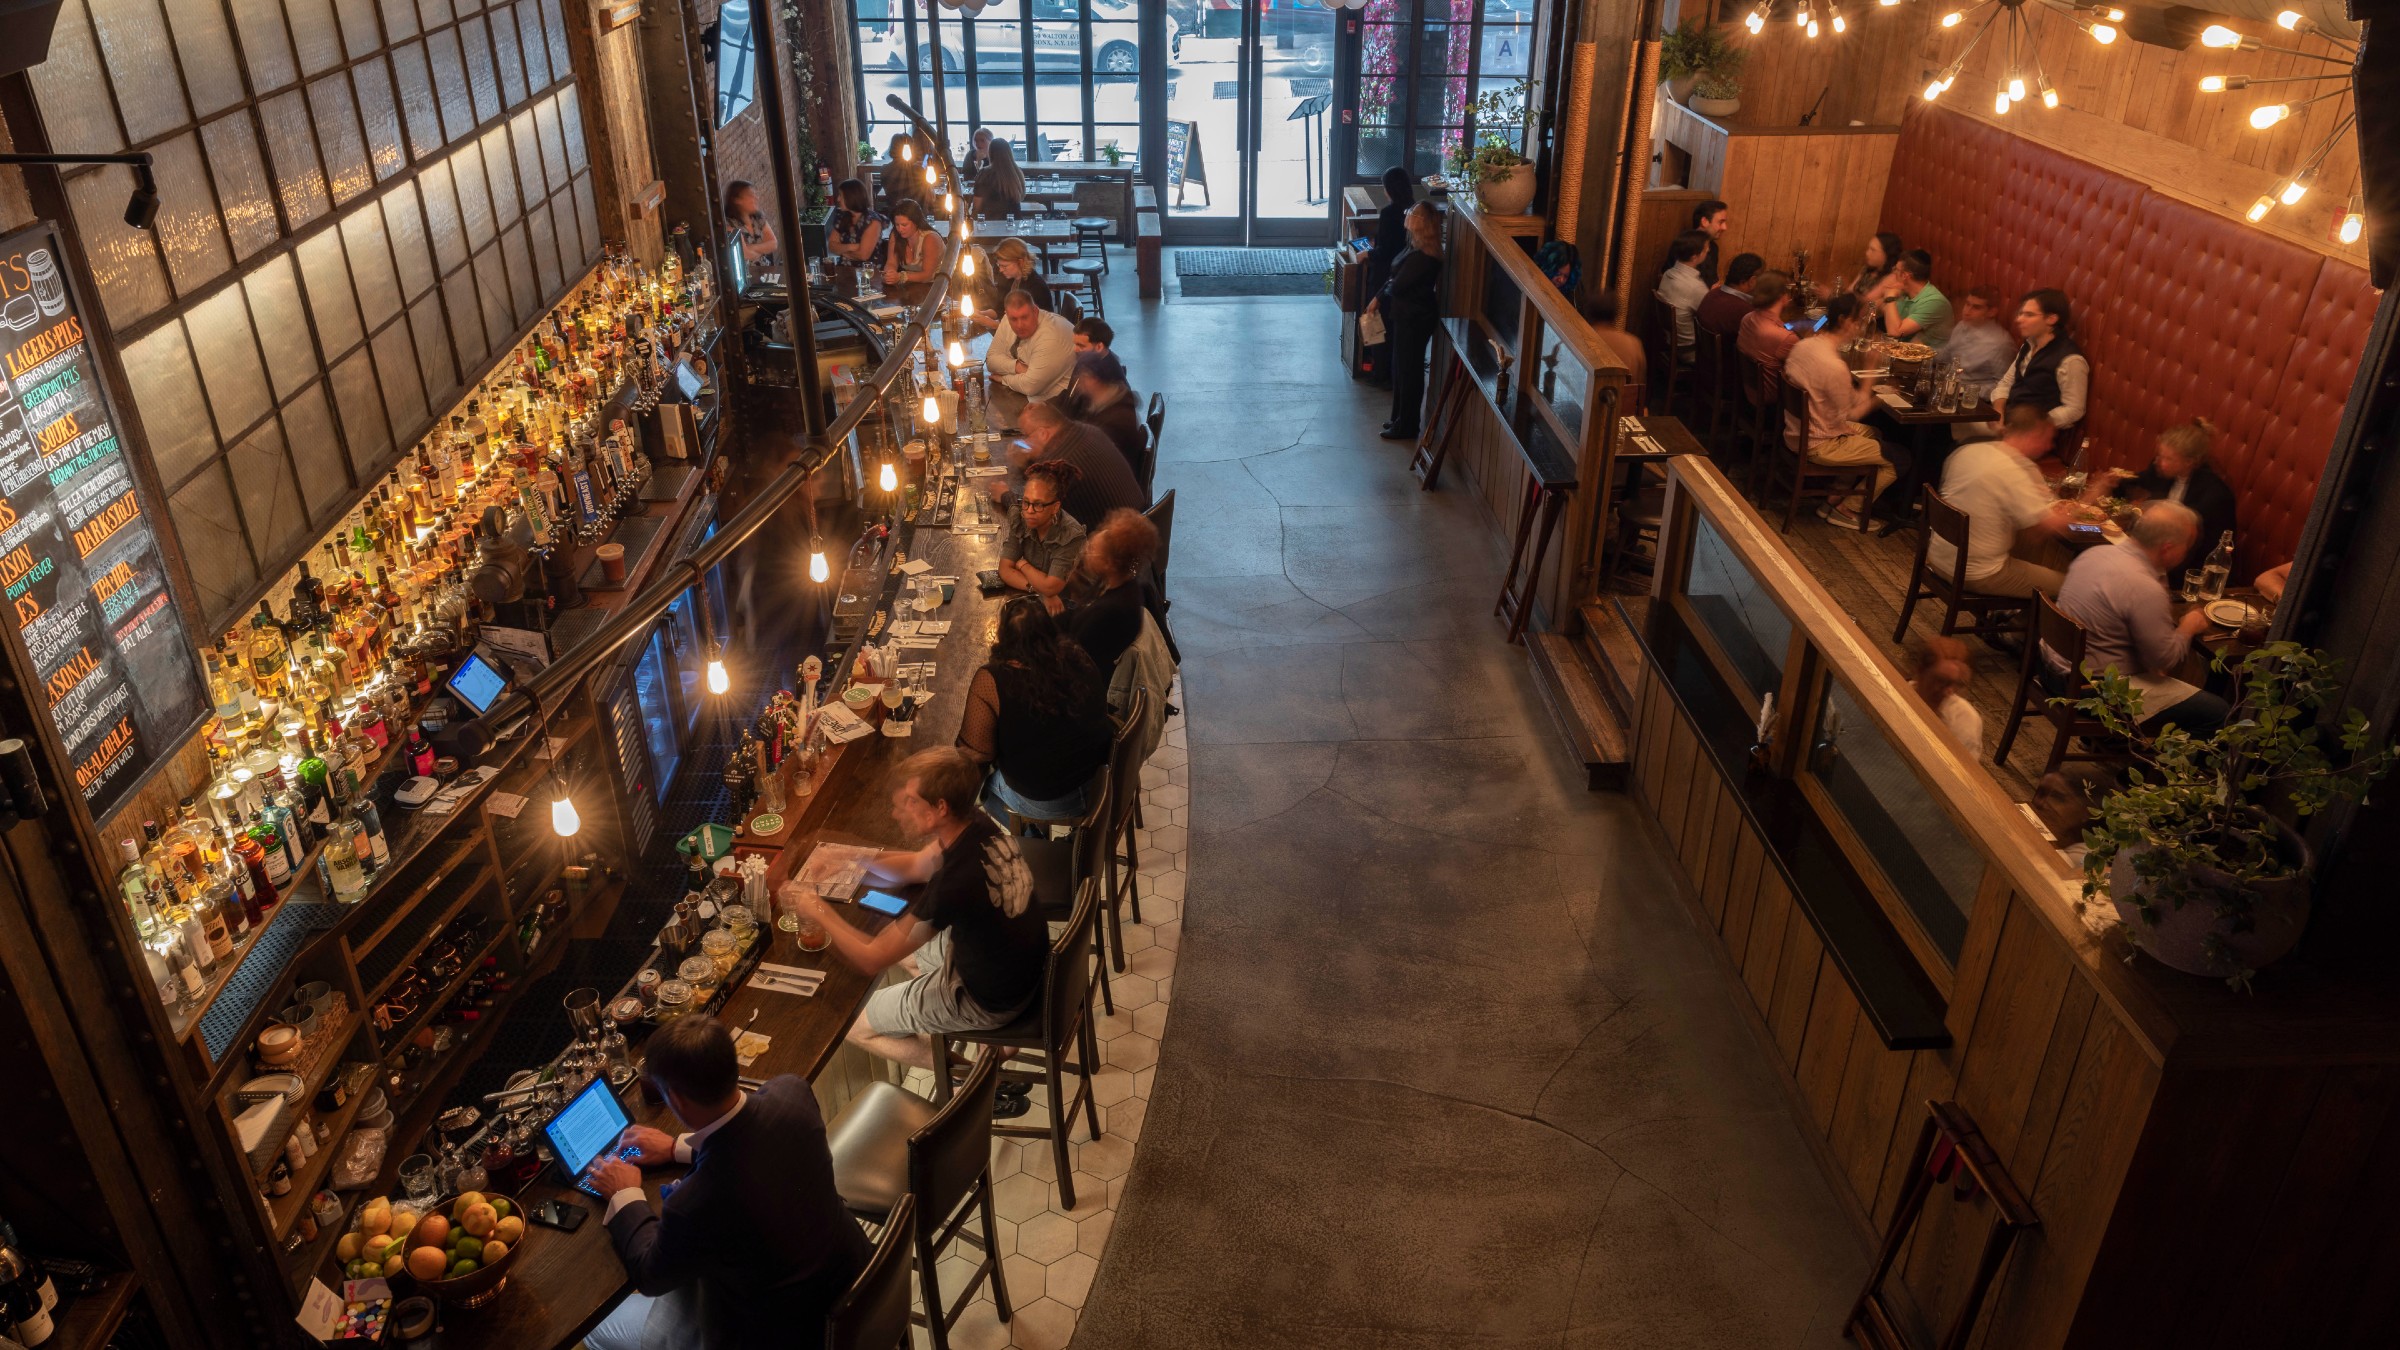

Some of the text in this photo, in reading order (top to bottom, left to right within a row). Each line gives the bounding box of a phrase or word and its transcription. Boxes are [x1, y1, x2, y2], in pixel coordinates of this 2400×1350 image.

[1499, 40, 1512, 56] A
[15, 367, 45, 392] BRAVEN
[44, 343, 84, 375] BUSHWICK
[23, 374, 64, 410] GREENPOINT
[62, 365, 80, 389] PILS
[29, 388, 73, 424] LAGUNITAS
[37, 412, 78, 452] SOURS
[56, 443, 74, 462] JAM
[71, 438, 82, 455] UP
[49, 459, 79, 488] RADIANT
[58, 490, 83, 515] TALEA
[579, 482, 595, 514] DOWNEAST
[5, 557, 54, 601] POINT REVER
[102, 592, 123, 614] EBBS
[42, 623, 62, 647] EXTRA
[60, 610, 78, 631] PALE
[74, 601, 90, 619] ALE
[57, 622, 83, 648] WHITE
[119, 620, 153, 655] JAI ALAI
[60, 690, 80, 715] CITY
[75, 666, 109, 700] OPTIMAL
[94, 697, 114, 721] WEST
[109, 682, 129, 708] COAST
[64, 700, 88, 730] ADAMS
[104, 760, 120, 780] RUN
[118, 745, 135, 766] WILD
